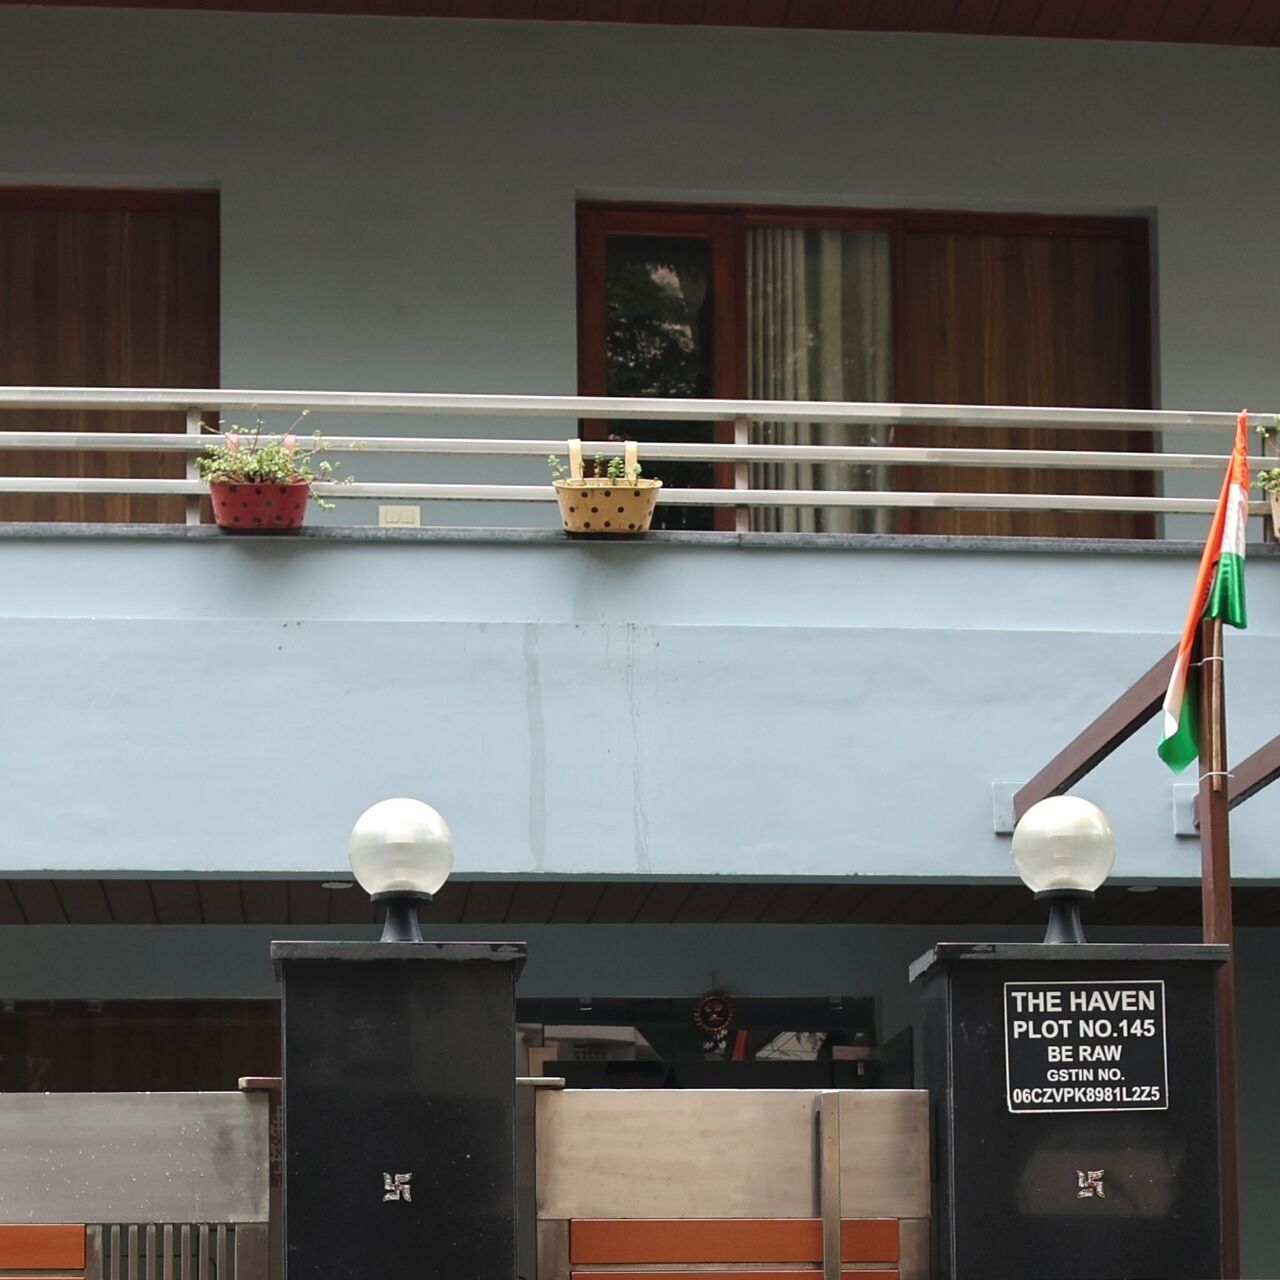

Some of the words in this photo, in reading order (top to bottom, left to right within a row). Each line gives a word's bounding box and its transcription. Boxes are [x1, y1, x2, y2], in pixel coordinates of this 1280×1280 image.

[1011, 991, 1062, 1013] THE
[1070, 990, 1155, 1012] HAVEN
[1013, 1020, 1072, 1039] PLOT
[1079, 1019, 1156, 1038] NO.145
[1047, 1046, 1074, 1062] BE
[1078, 1045, 1122, 1062] RAW
[1046, 1069, 1094, 1082] GSTIN
[1098, 1068, 1126, 1081] NO.
[1013, 1086, 1160, 1104] 06CZVPK8981L2Z5
